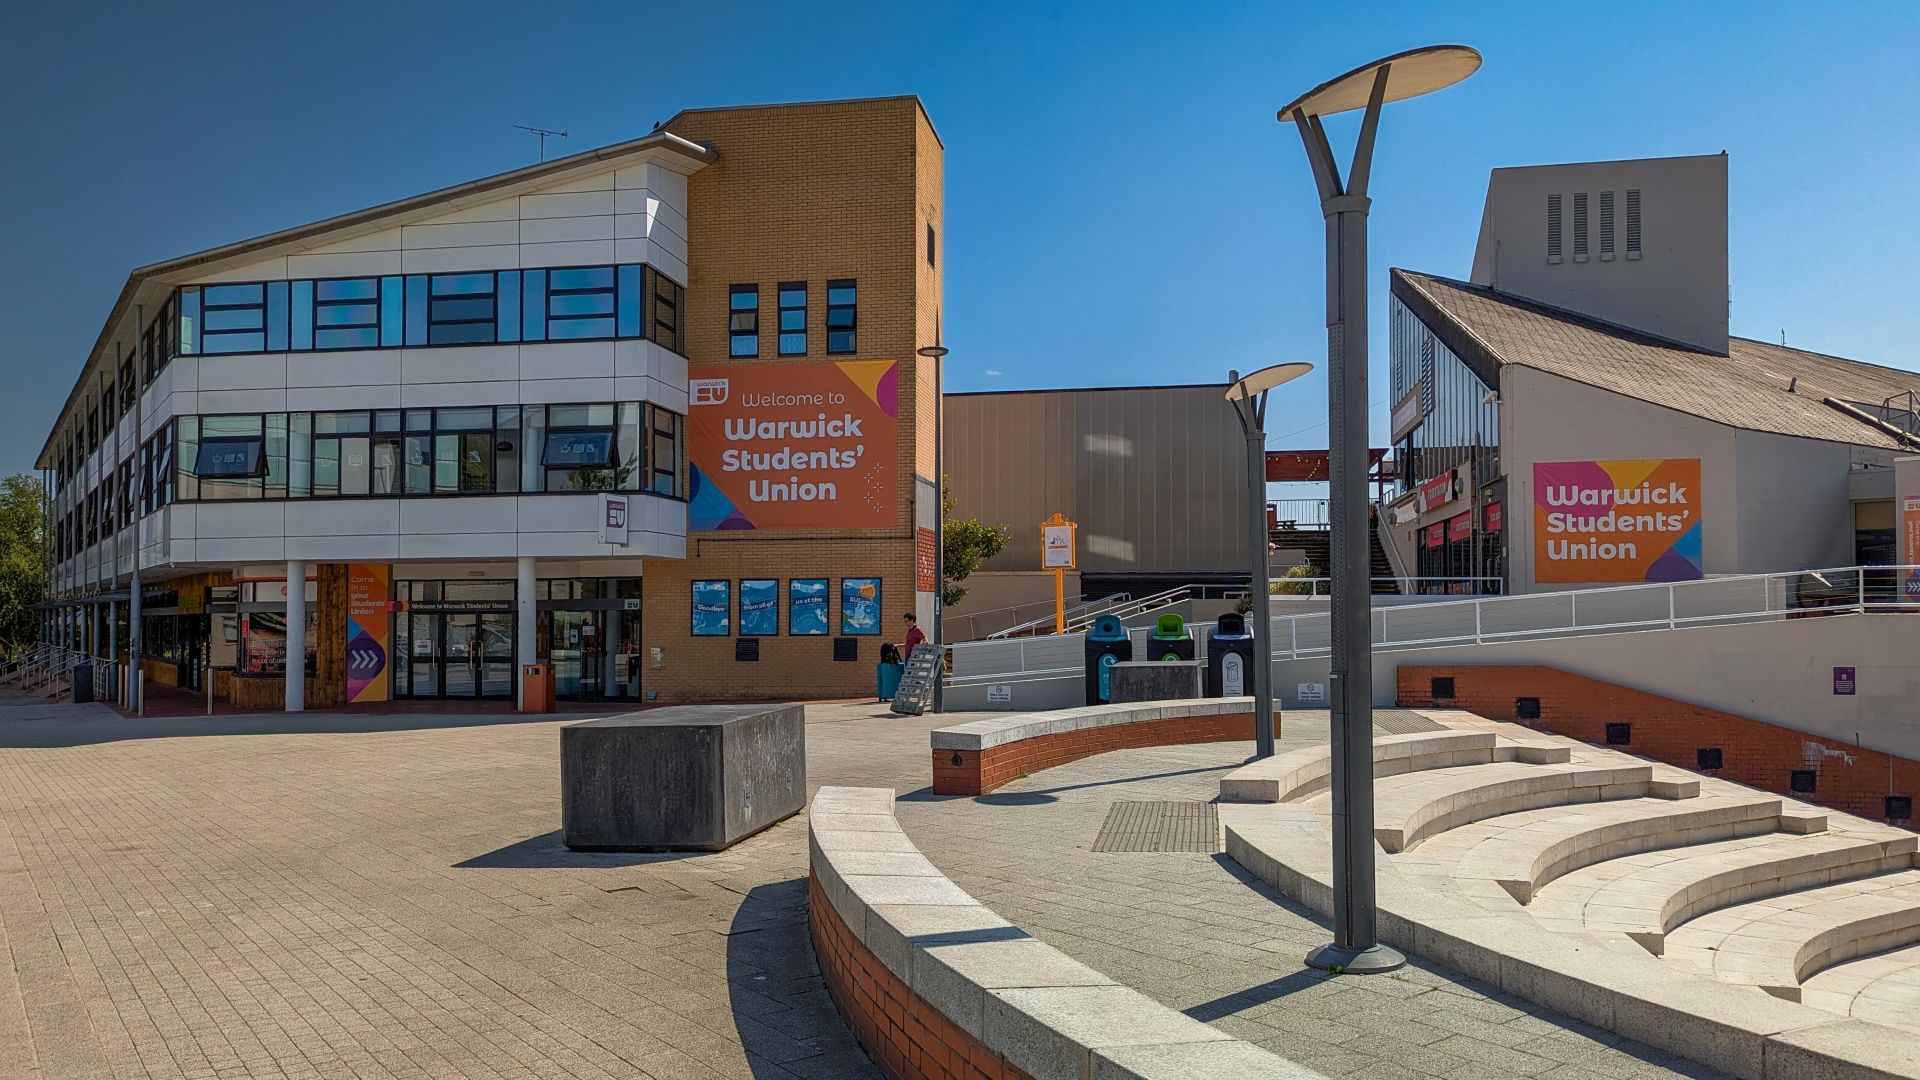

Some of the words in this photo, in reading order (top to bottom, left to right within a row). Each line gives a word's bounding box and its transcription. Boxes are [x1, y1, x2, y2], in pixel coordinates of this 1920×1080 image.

[742, 392, 824, 407] Welcome
[828, 392, 845, 405] to
[724, 413, 864, 441] Warwick
[722, 445, 864, 472] Students'
[749, 476, 837, 502] Union
[1546, 482, 1687, 506] Warwick
[1547, 510, 1690, 532] Students'
[1548, 537, 1637, 560] Union
